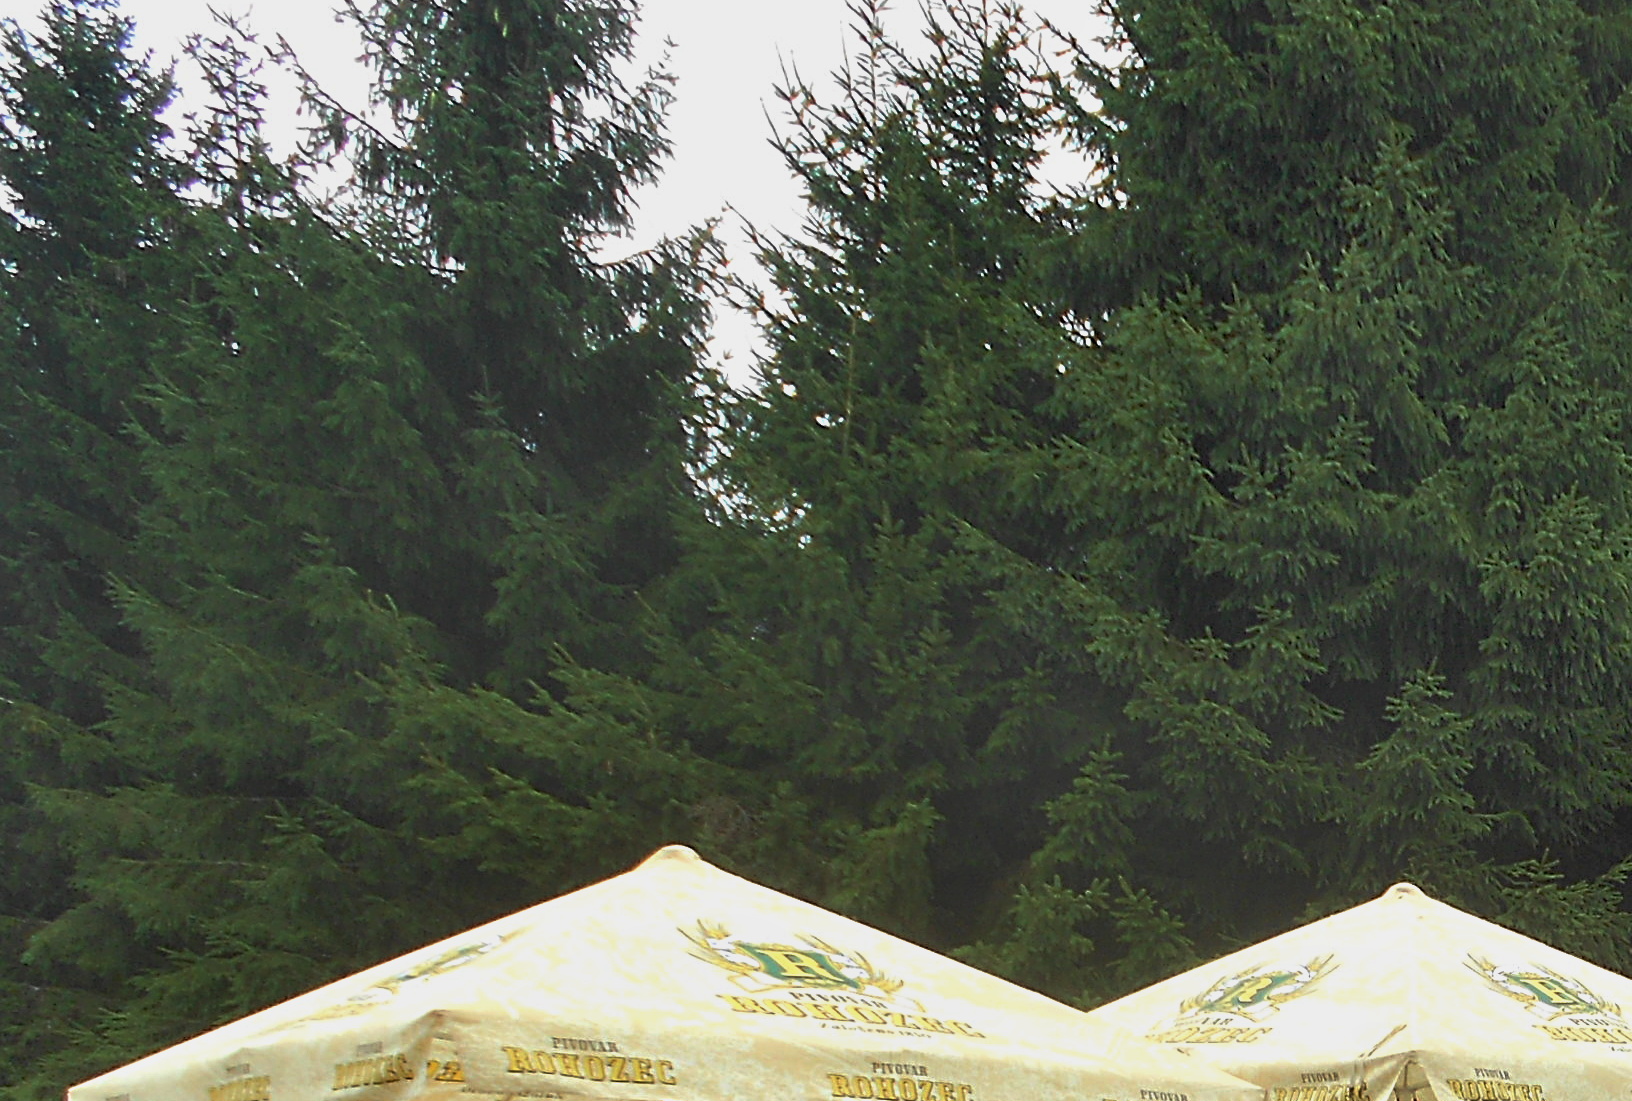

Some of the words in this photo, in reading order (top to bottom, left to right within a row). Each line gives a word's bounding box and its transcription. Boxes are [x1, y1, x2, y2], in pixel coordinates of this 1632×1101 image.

[757, 949, 848, 983] R
[715, 993, 987, 1040] ROHOZEC
[552, 1037, 618, 1053] PIVOVAR
[502, 1046, 677, 1086] ROHOZEC
[872, 1062, 928, 1077] PIVOVAR
